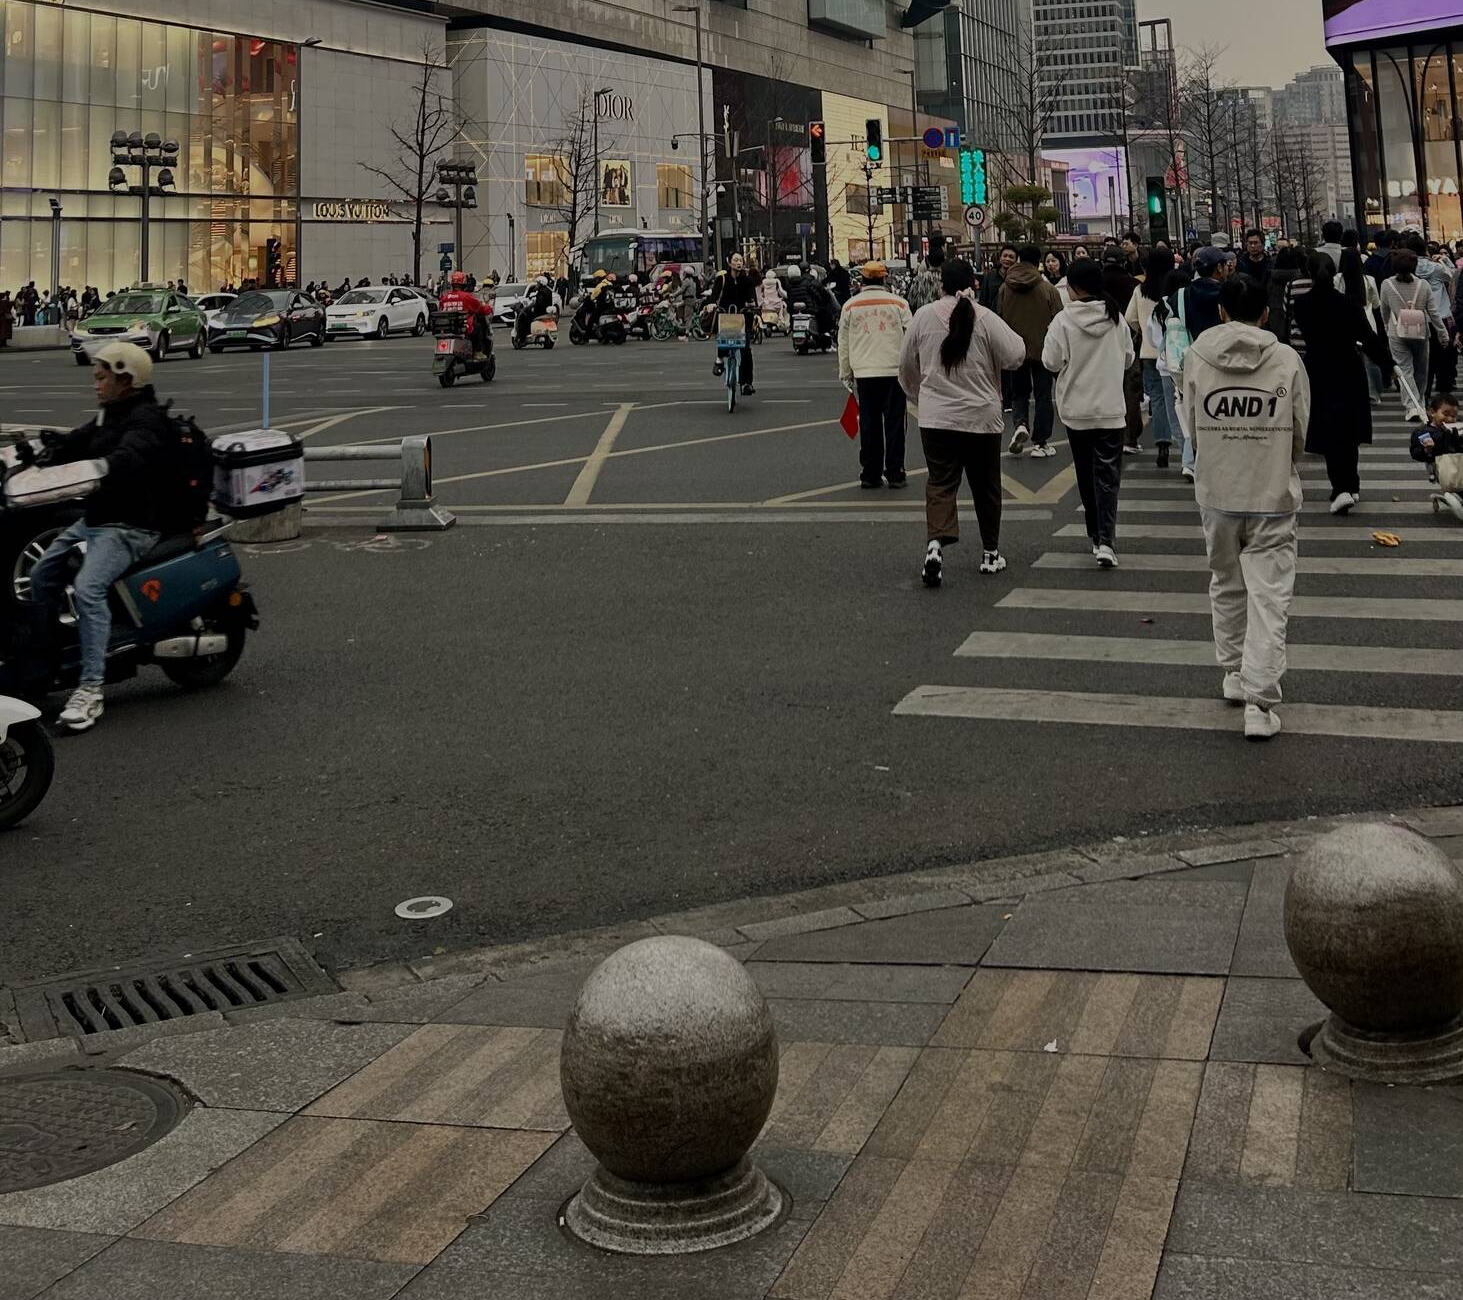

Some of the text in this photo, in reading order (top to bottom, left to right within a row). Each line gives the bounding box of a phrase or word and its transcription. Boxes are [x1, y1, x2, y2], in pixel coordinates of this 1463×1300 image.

[597, 93, 634, 121] DIOR
[968, 211, 982, 220] 40
[1214, 396, 1278, 418] AND 1
